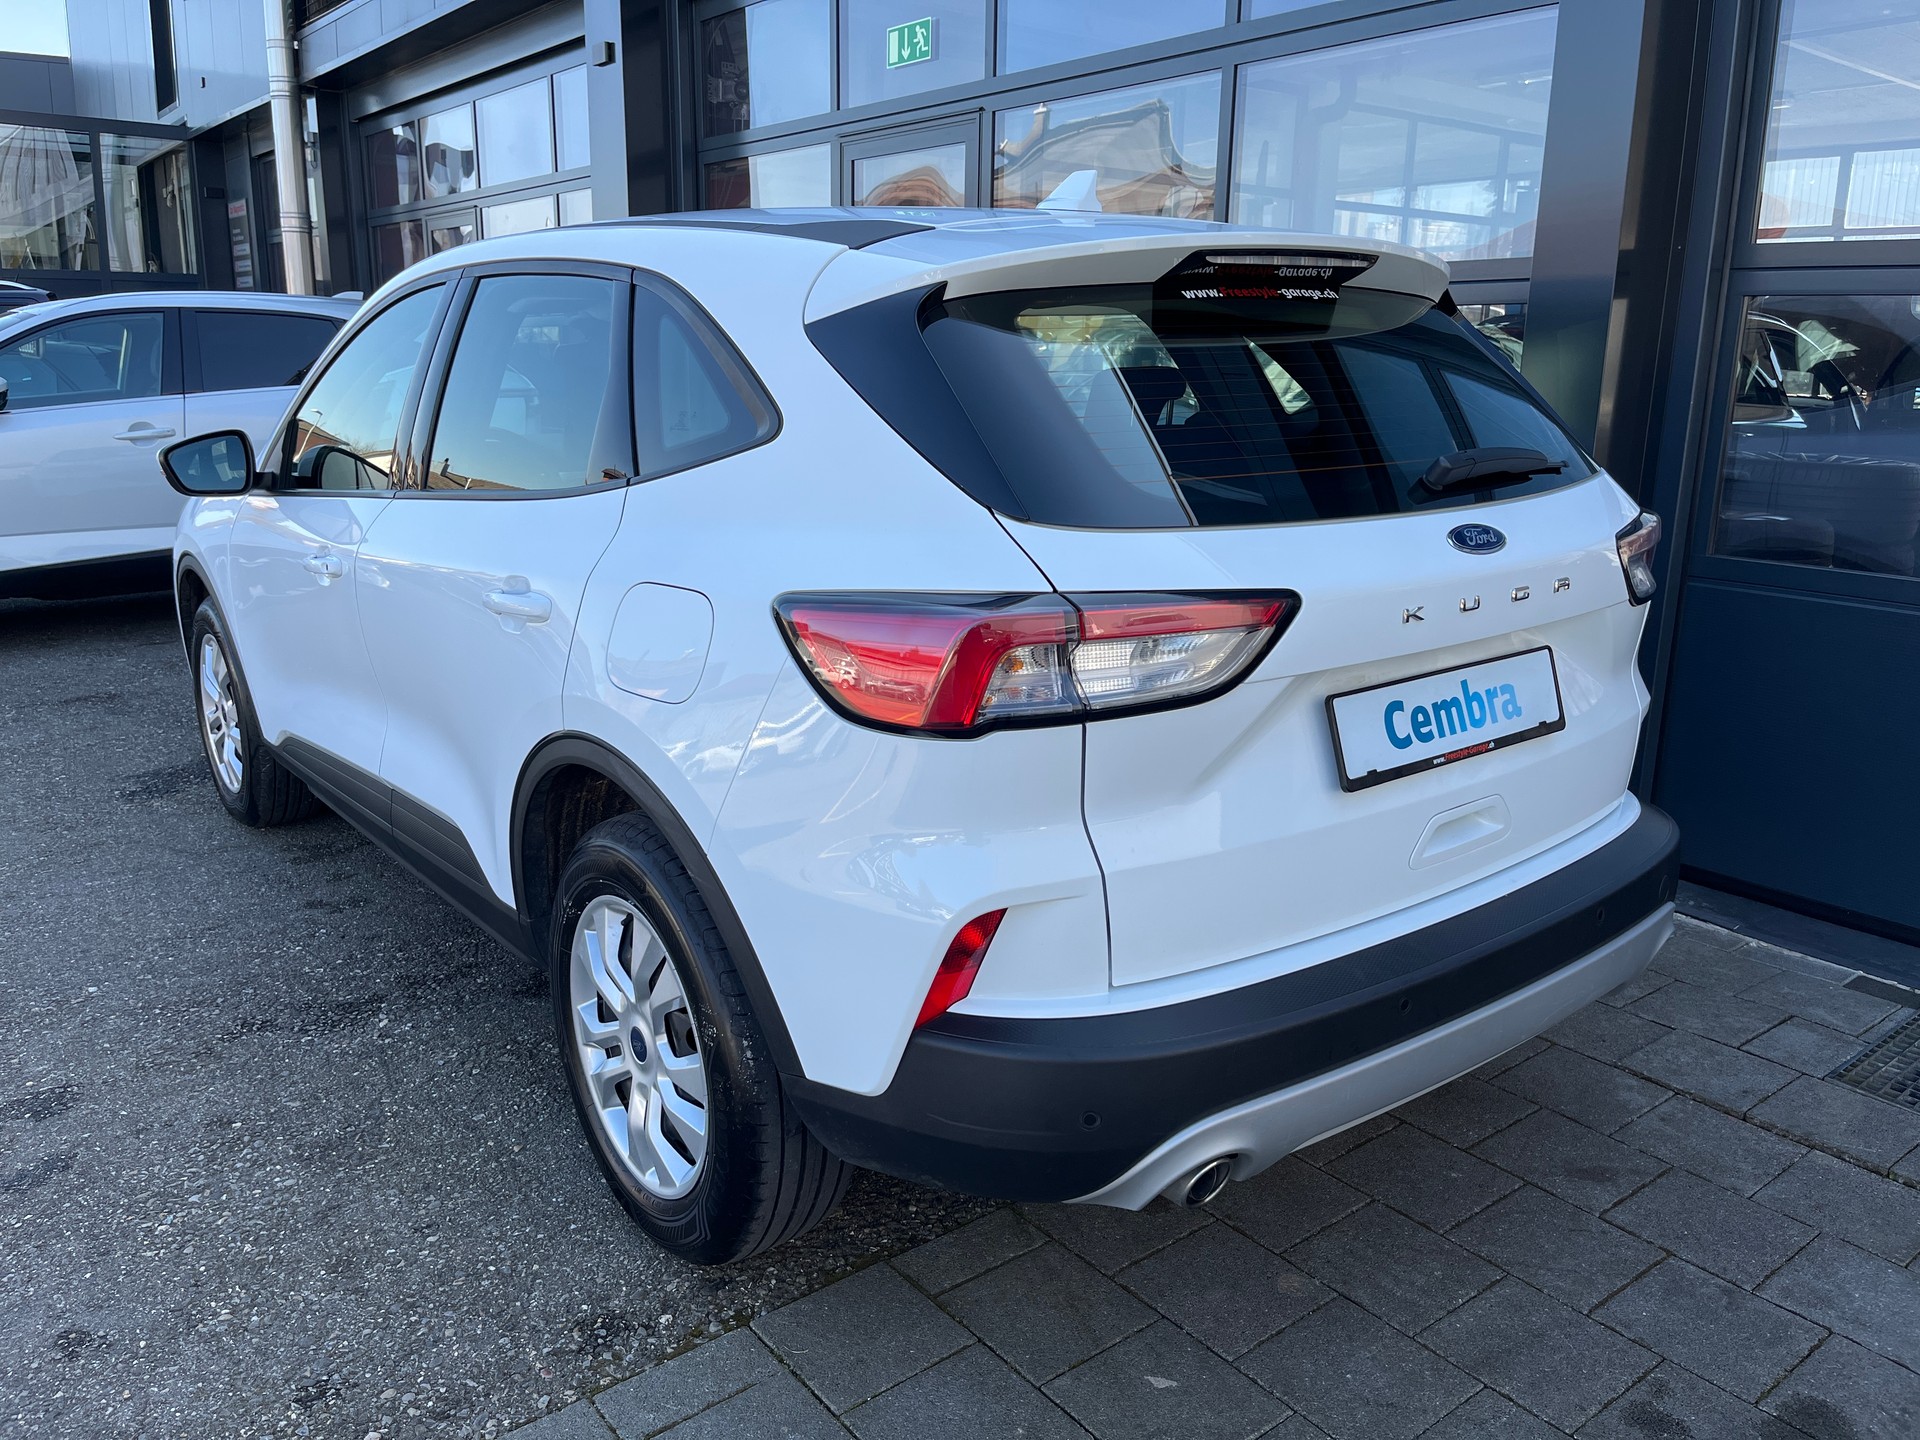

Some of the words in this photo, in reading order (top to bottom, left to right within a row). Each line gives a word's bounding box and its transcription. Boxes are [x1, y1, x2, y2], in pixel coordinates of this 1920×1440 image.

[1181, 286, 1339, 300] www.Freestyle-garage.ch
[1464, 527, 1498, 546] Ford
[1402, 576, 1571, 624] KUGA
[1384, 678, 1522, 750] Cembra
